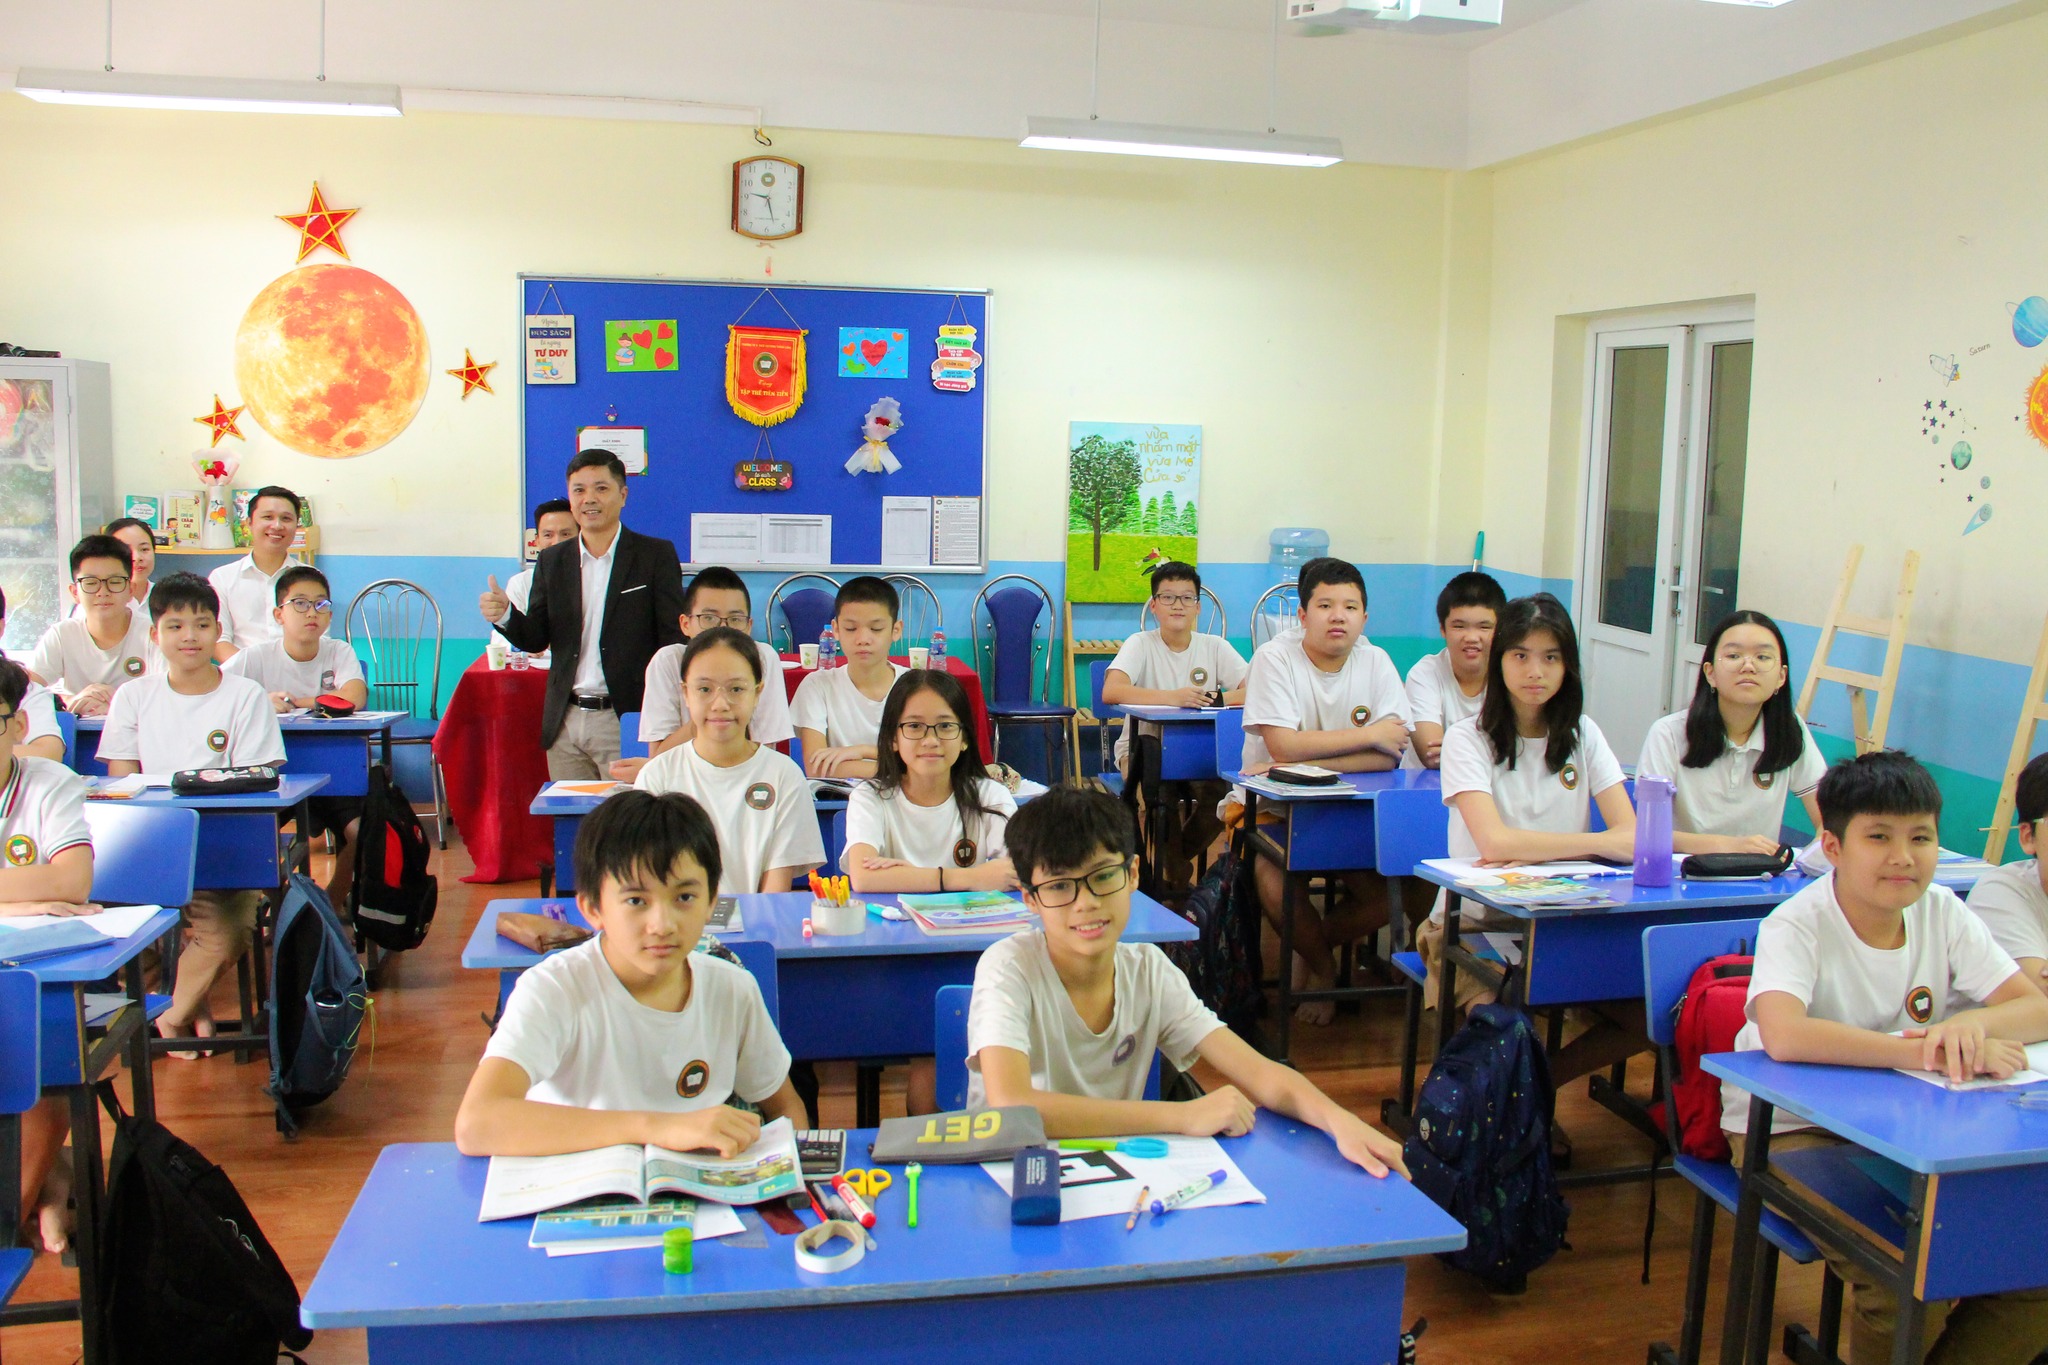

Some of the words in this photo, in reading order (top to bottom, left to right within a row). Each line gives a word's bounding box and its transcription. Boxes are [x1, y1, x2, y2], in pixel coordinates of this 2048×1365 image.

[764, 162, 773, 170] 12
[535, 348, 546, 357] TƯ
[1970, 343, 1990, 356] Saturn
[743, 464, 782, 472] WELCOME
[749, 477, 776, 486] CLASS
[917, 1110, 1001, 1143] GET
